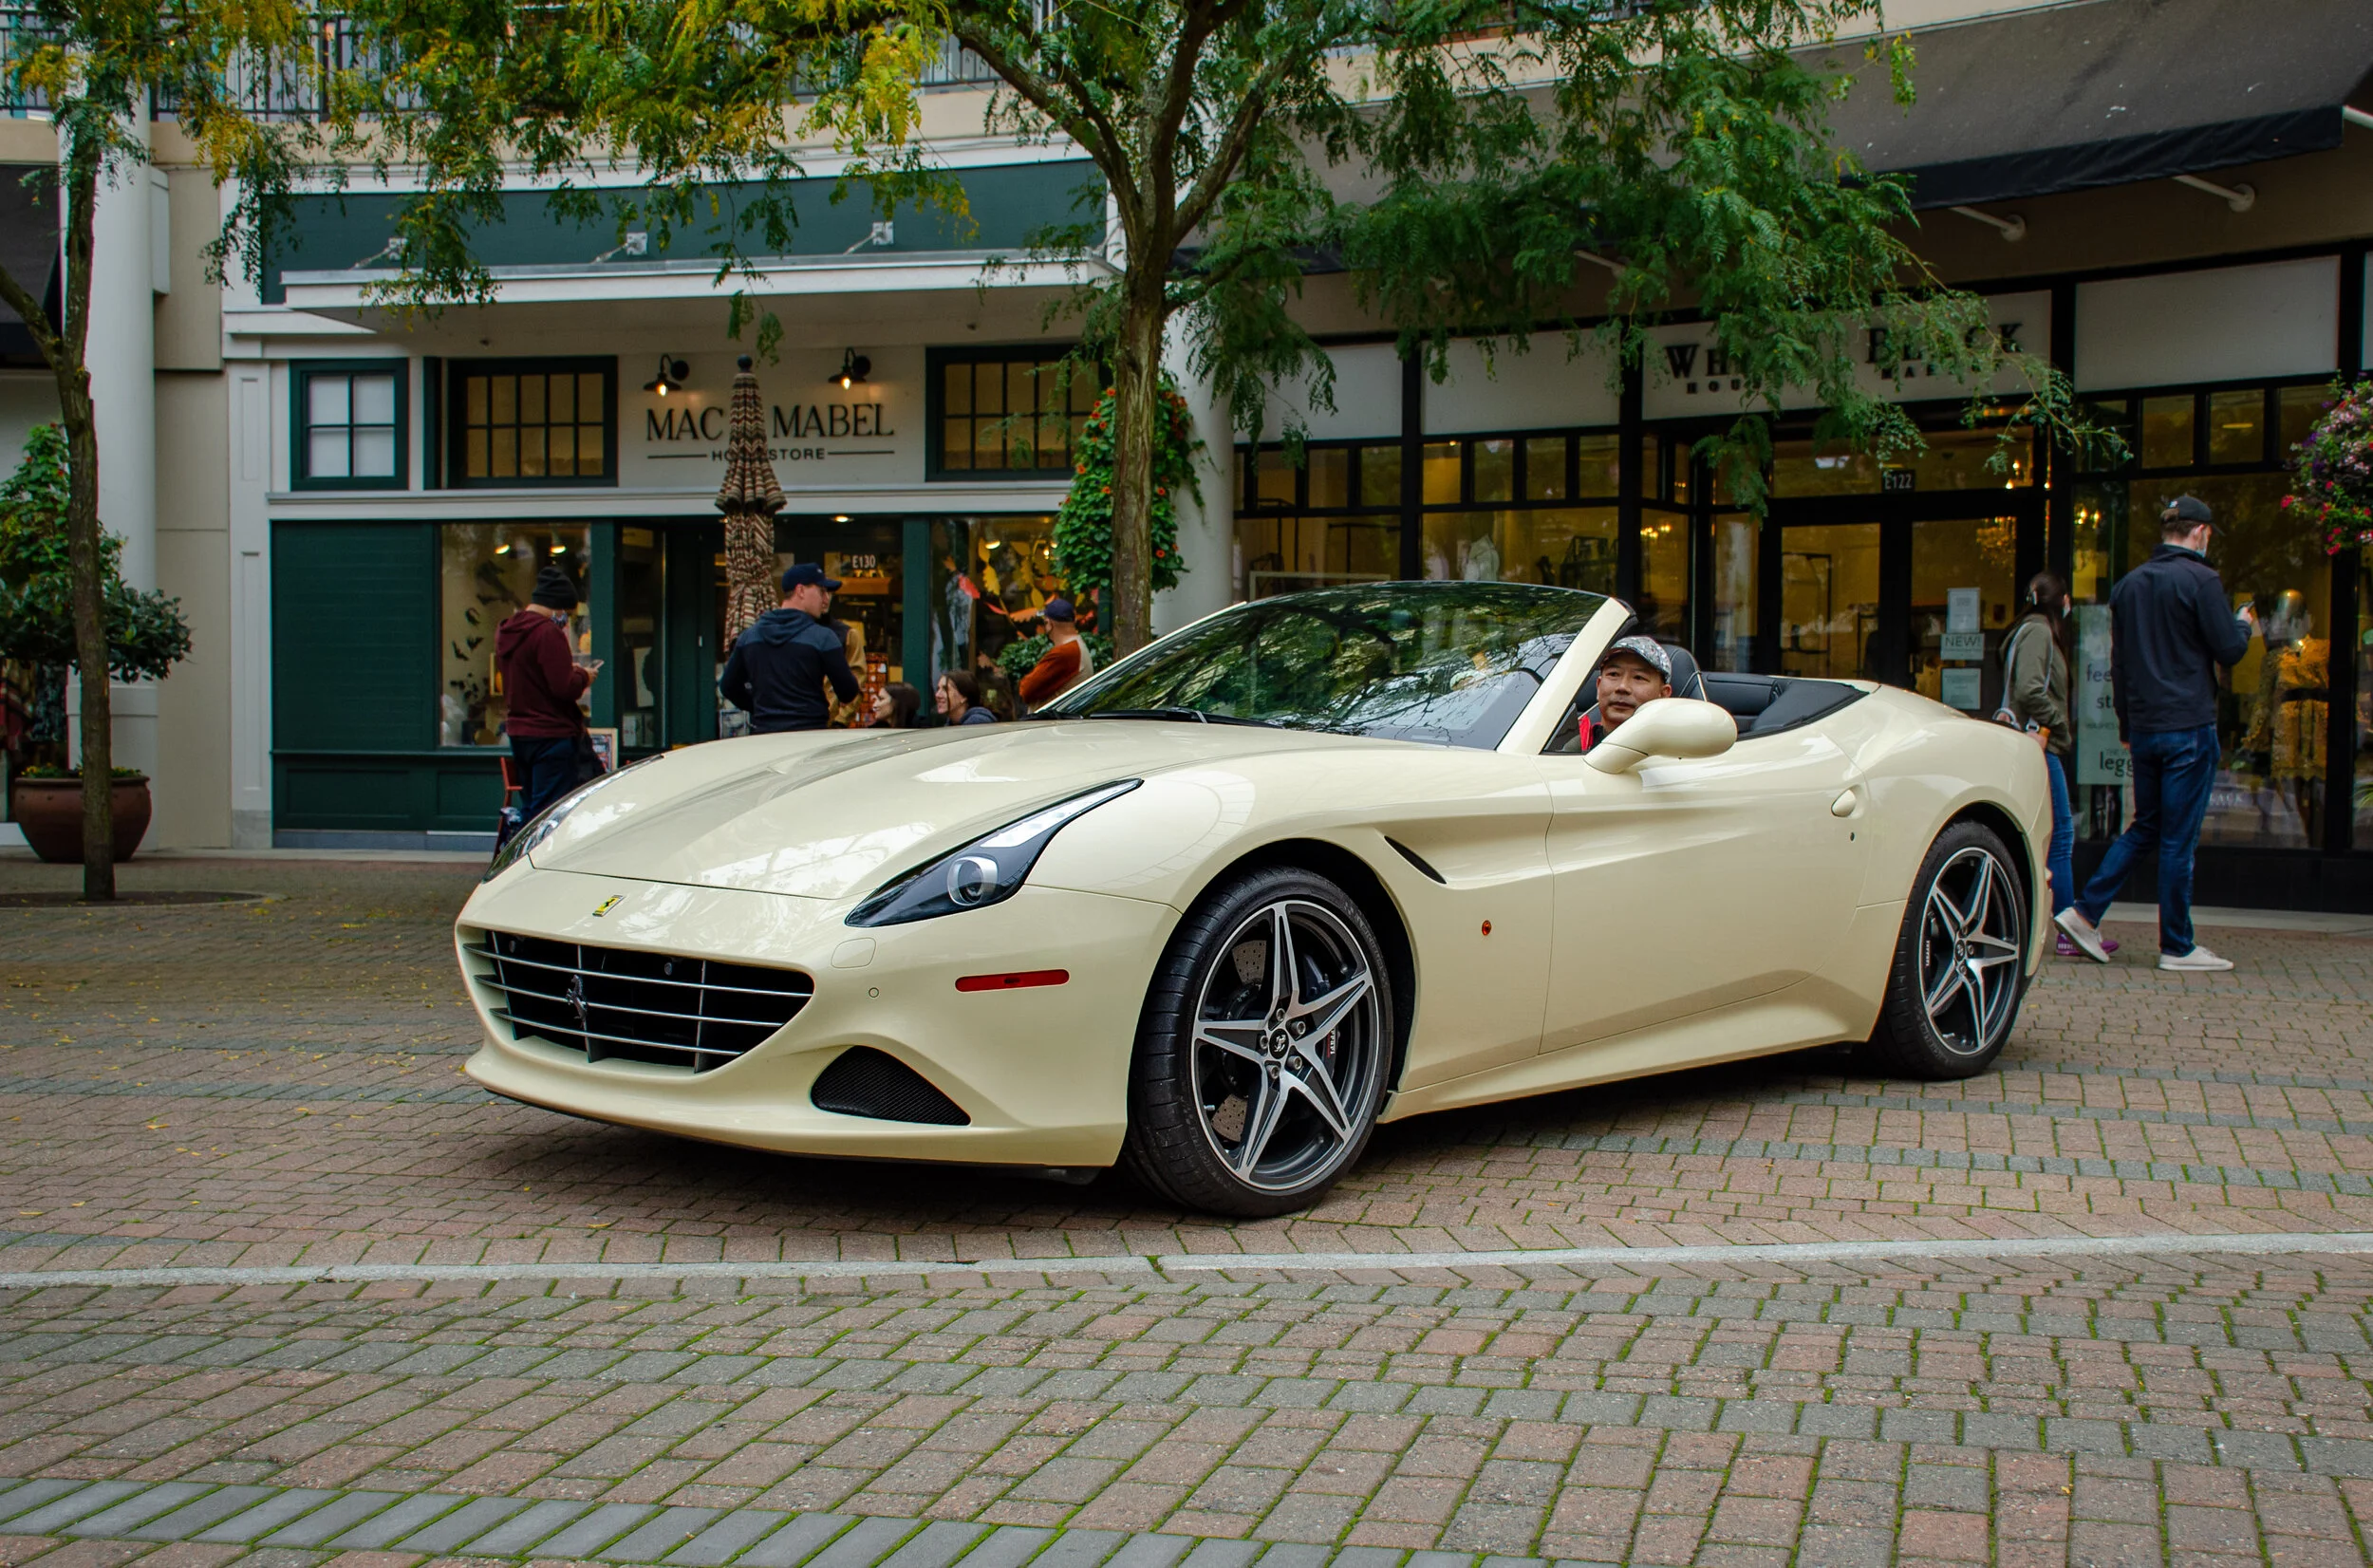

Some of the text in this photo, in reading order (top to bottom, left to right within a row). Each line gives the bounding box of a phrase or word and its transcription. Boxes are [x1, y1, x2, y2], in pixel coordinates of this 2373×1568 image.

[1865, 323, 2024, 364] BLCK
[646, 403, 894, 440] MAC MABEL
[768, 448, 825, 460] STORE
[1884, 474, 1912, 490] E122
[852, 554, 876, 569] E130
[2096, 696, 2113, 709] st
